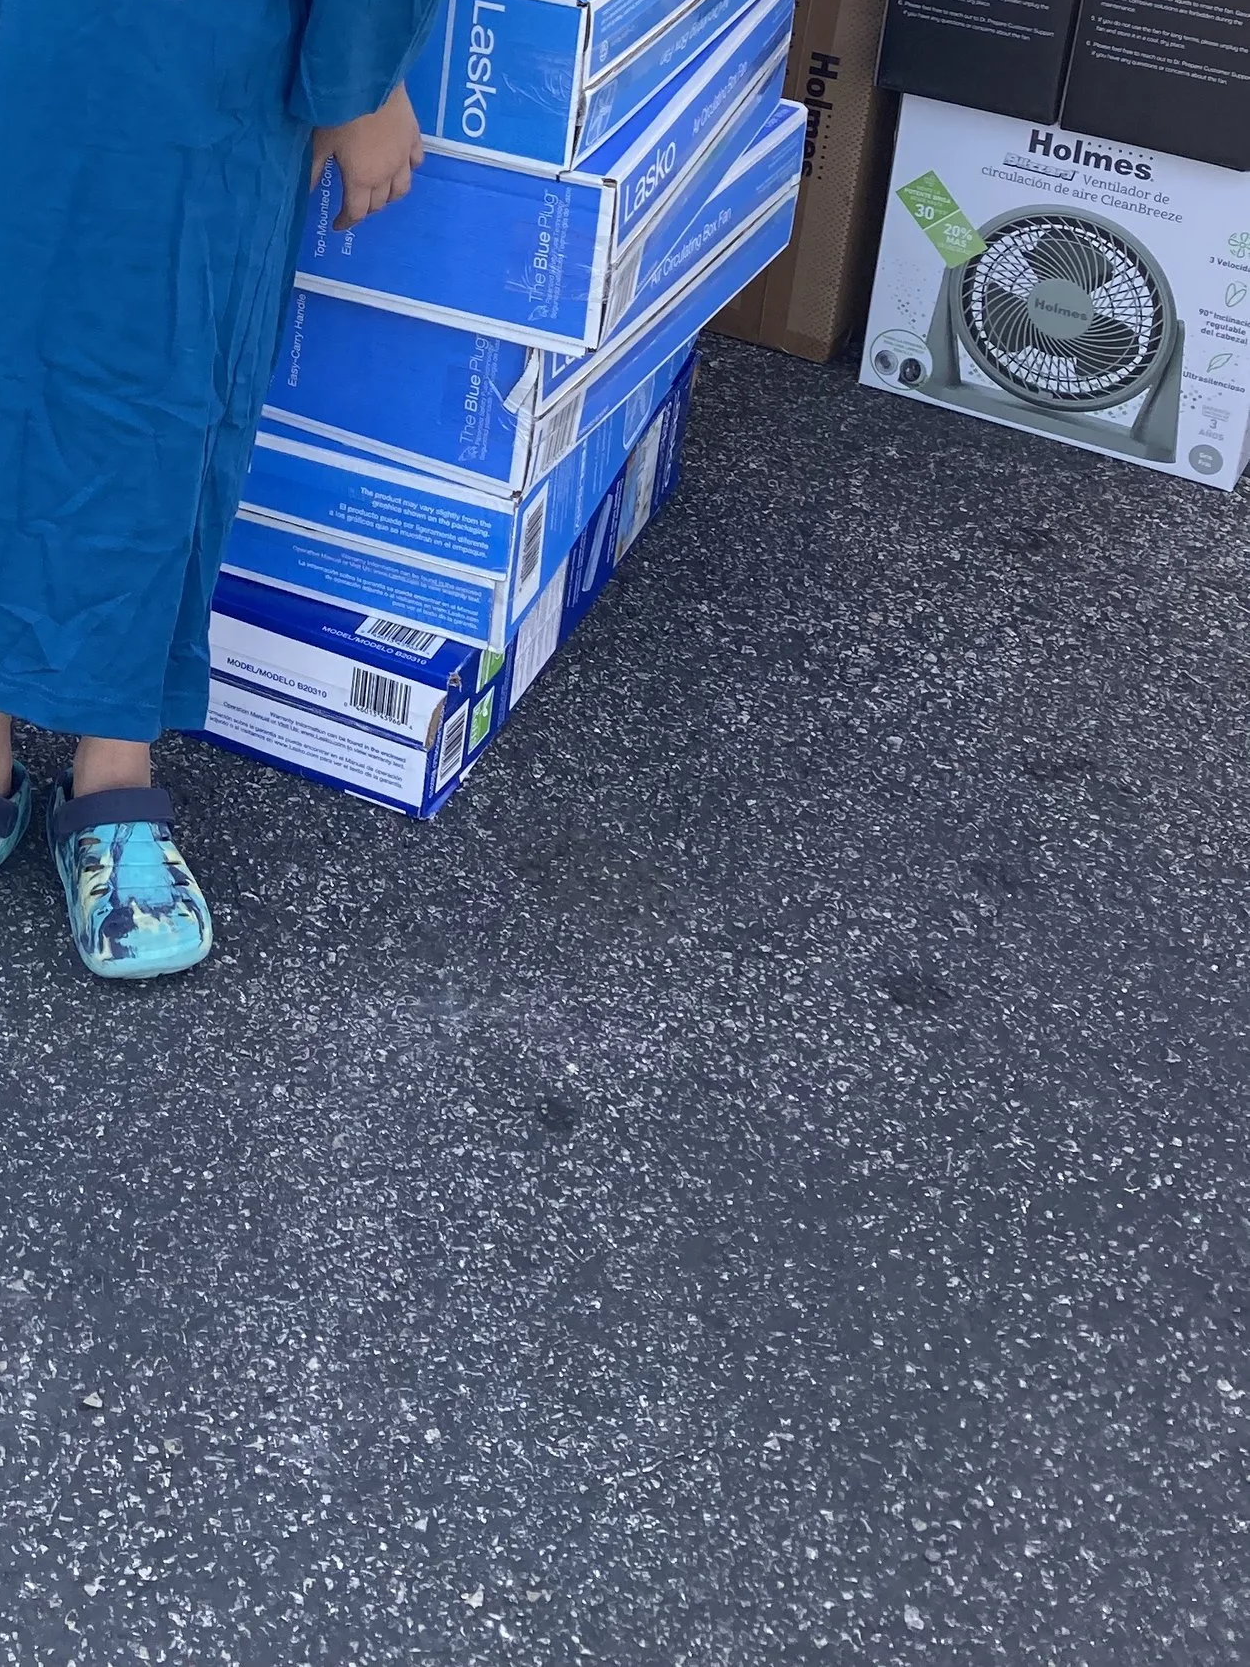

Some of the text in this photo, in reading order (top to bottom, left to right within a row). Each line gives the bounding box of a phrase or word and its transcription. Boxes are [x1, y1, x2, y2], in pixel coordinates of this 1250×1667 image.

[462, 0, 506, 138] Lasko
[802, 51, 840, 178] Holmes
[624, 140, 676, 224] Lasko
[1028, 129, 1154, 182] Holmes
[915, 204, 935, 221] 30
[981, 166, 1183, 223] circulación de aire CleanBreeze
[1083, 174, 1152, 200] Ventilador
[1154, 192, 1170, 205] de
[529, 192, 559, 303] The Blue Plug
[663, 232, 703, 276] Circulating
[702, 220, 718, 244] Box
[717, 206, 732, 230] Fan
[288, 293, 306, 387] Easy-Carry Handle
[1200, 327, 1248, 346] del cabezal
[1206, 320, 1246, 336] regulable
[460, 335, 490, 444] The Blue Plug
[1183, 372, 1245, 393] Ultrasilencioso
[321, 625, 428, 665] MODEL/MODELO B20310
[226, 656, 328, 699] MODEL/MODELO B20310
